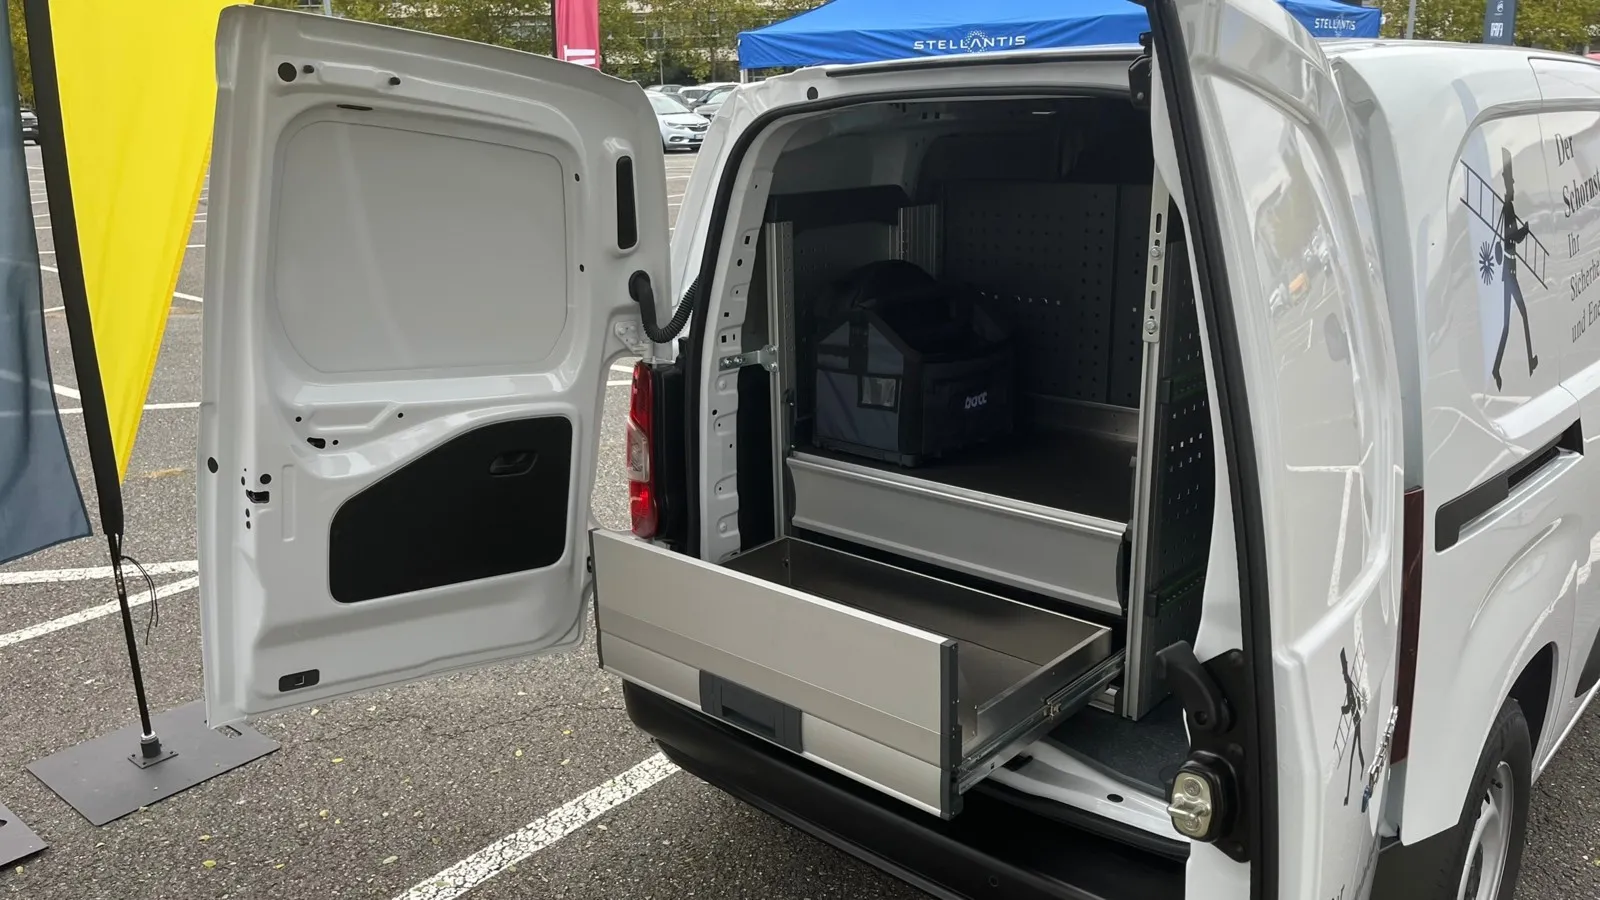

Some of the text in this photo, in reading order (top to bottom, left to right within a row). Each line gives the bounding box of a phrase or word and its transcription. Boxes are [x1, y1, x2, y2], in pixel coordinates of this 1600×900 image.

[1314, 18, 1356, 31] STELLANTIS
[913, 35, 1026, 50] STELLANTIS
[1554, 133, 1574, 167] Der
[1568, 232, 1580, 259] Ihr
[1570, 254, 1600, 302] Sicherhe
[1572, 308, 1586, 343] und
